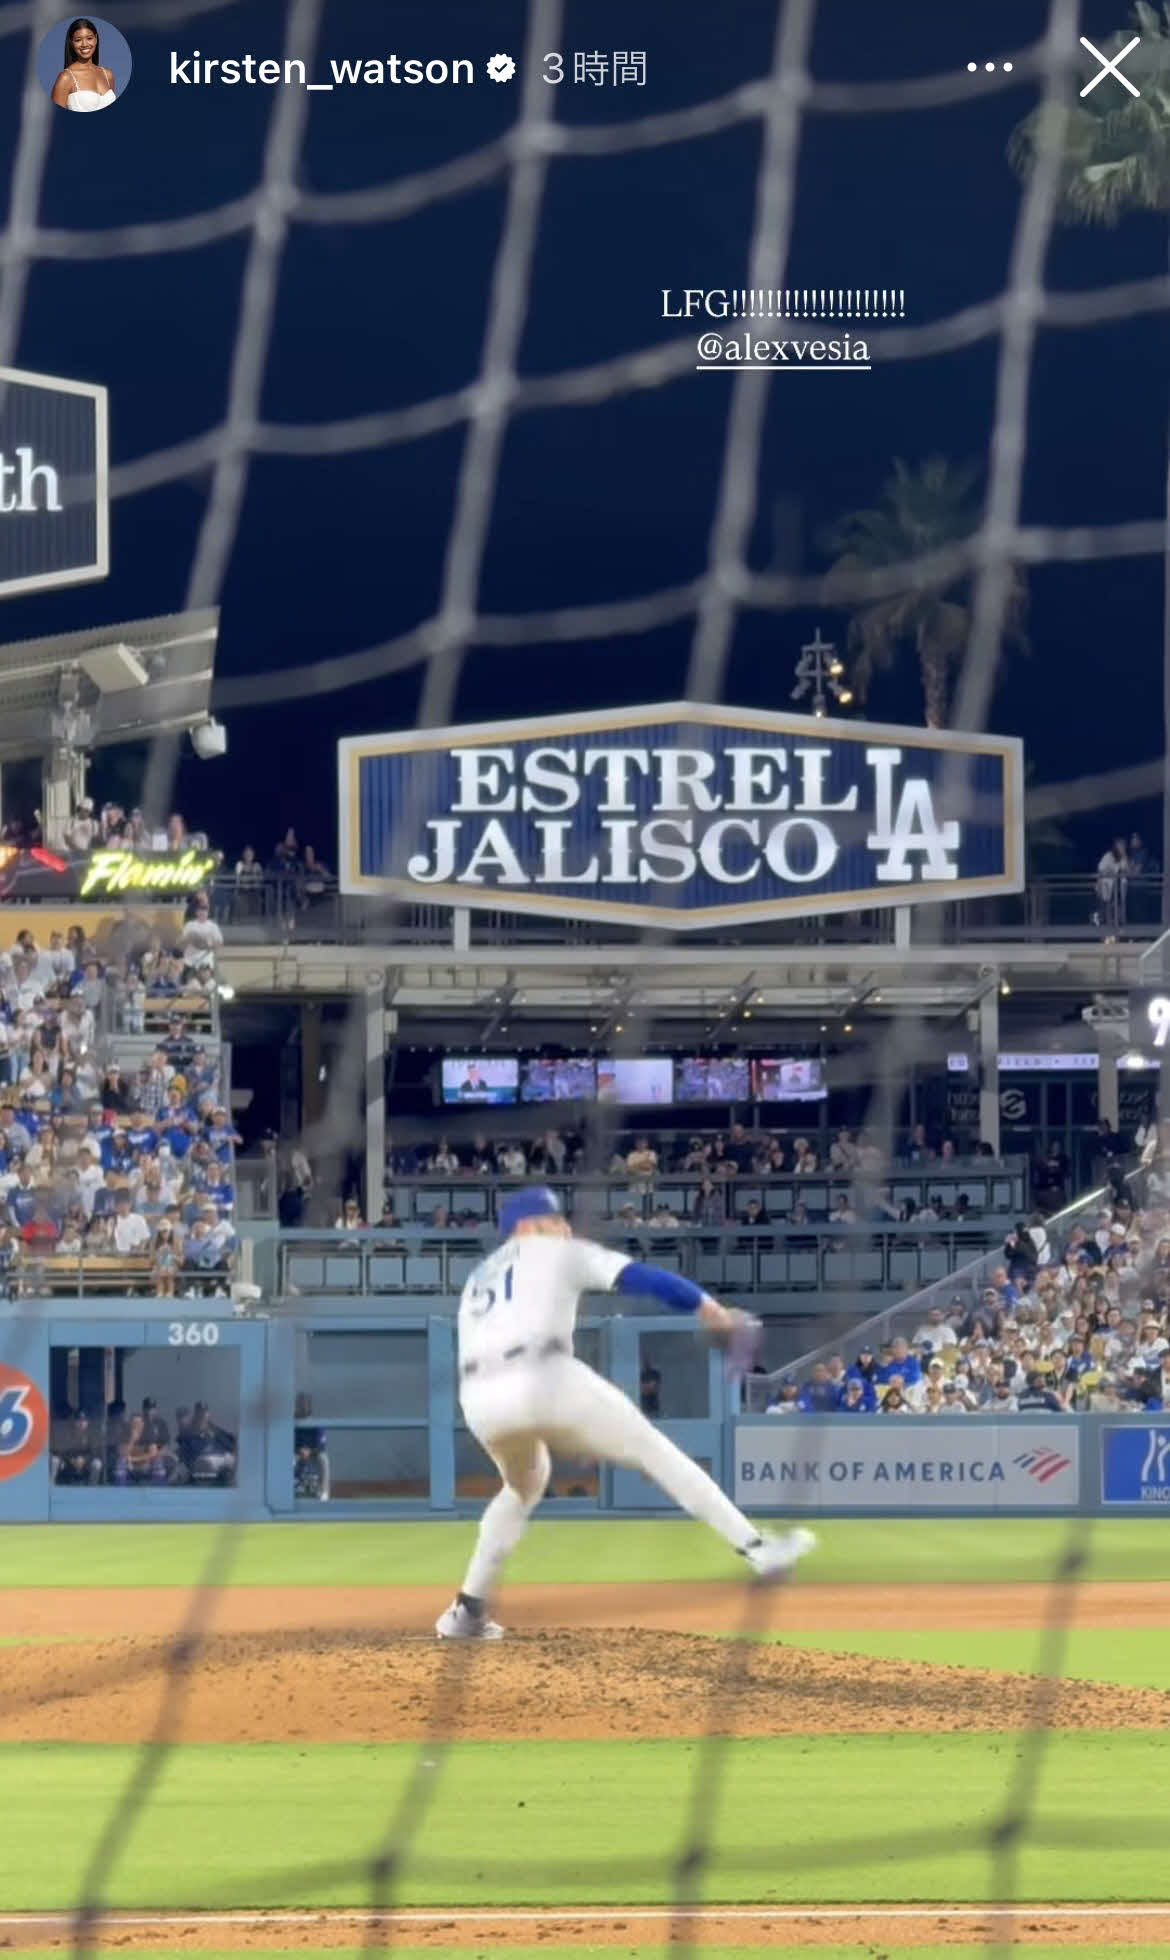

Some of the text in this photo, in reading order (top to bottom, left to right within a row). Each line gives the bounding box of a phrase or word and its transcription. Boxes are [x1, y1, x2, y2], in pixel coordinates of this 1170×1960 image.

[449, 747, 858, 812] ESTREL
[866, 749, 960, 881] LA
[408, 818, 838, 884] JALISCO
[168, 1323, 219, 1345] 360
[741, 1461, 1005, 1481] BANK OF AMERICA
